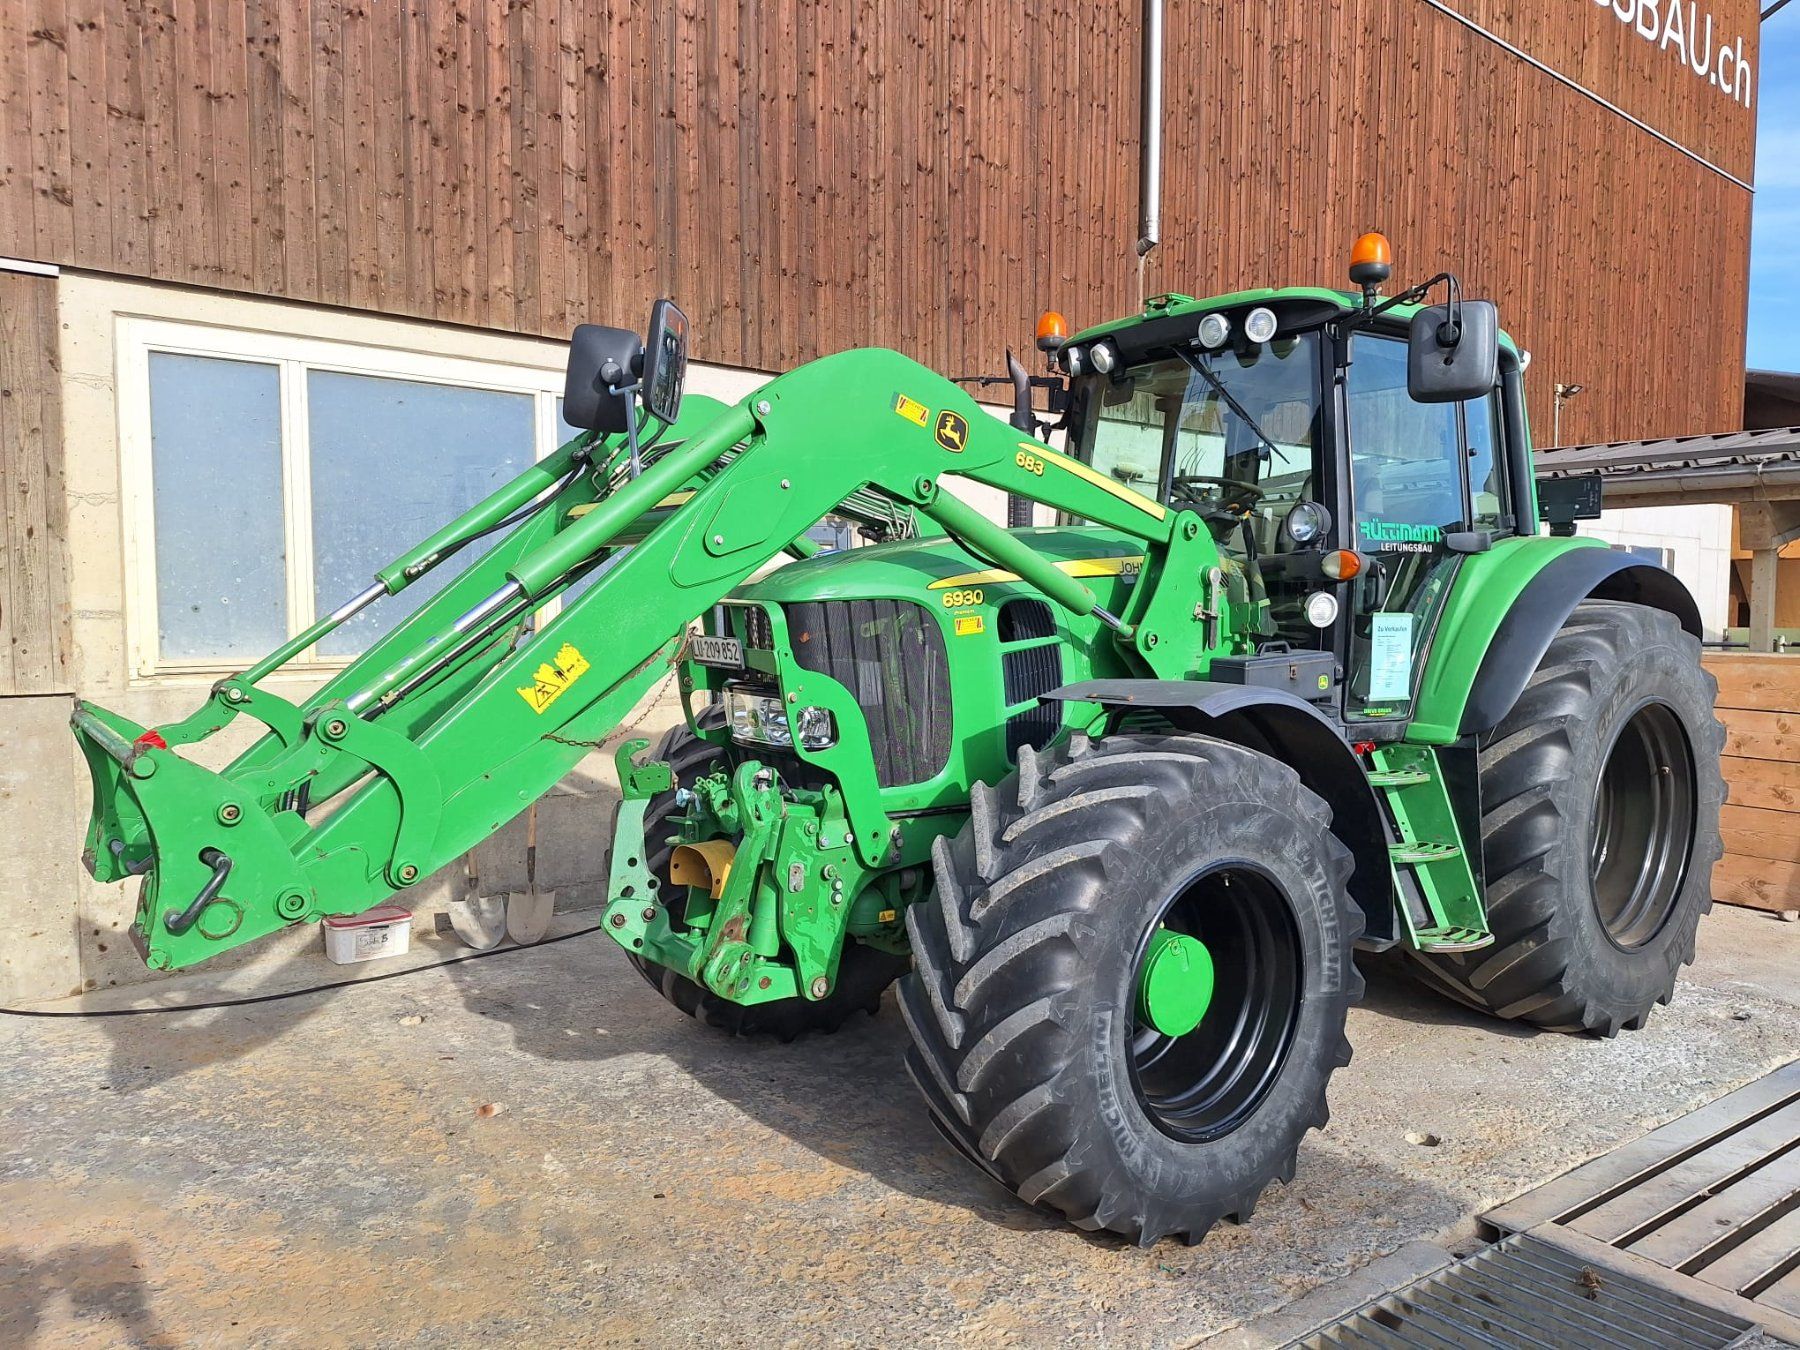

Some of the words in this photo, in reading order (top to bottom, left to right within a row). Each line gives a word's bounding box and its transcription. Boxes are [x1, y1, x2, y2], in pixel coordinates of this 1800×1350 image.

[1016, 451, 1044, 476] 683
[1380, 542, 1433, 553] LEITUNGSBAU
[943, 589, 984, 608] 6930
